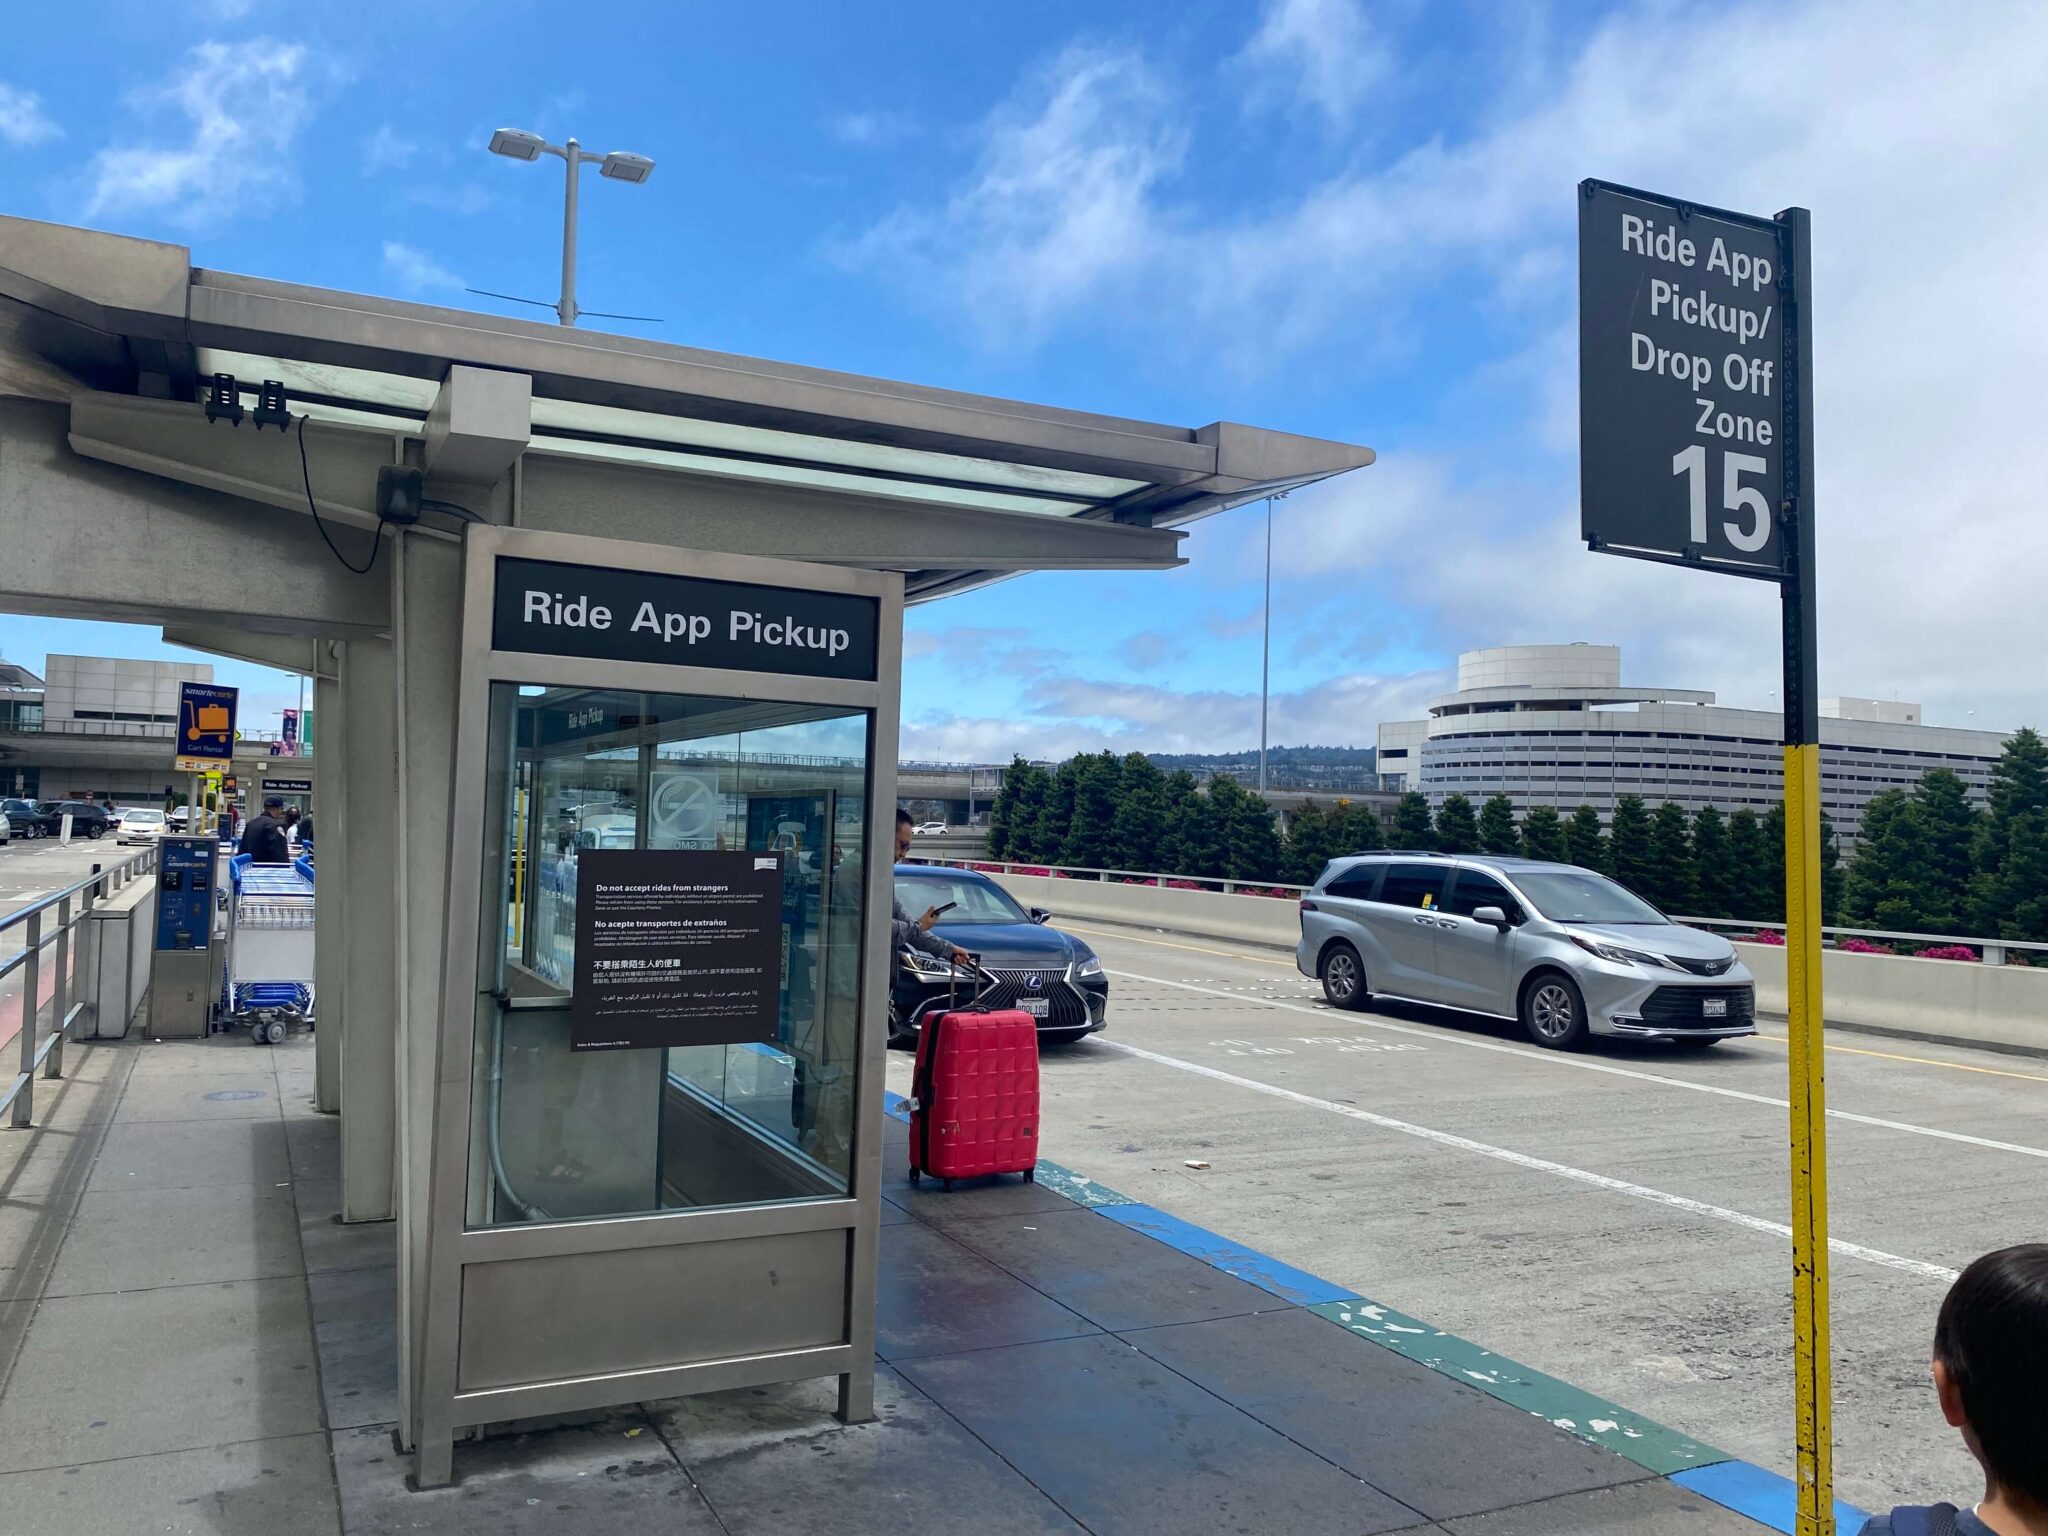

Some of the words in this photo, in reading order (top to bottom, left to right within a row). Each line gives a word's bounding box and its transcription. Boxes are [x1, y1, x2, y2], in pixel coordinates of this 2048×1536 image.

[1621, 213, 1696, 267] Ride
[1706, 237, 1772, 291] App
[1651, 278, 1772, 344] Pickup/
[1631, 332, 1712, 391] Drop
[1723, 353, 1774, 396] Off
[1695, 398, 1773, 446] Zone
[1672, 444, 1771, 553] 15
[523, 590, 612, 630] Ride
[630, 601, 711, 645] App
[729, 610, 850, 657] Pickup
[578, 710, 588, 730] App
[588, 706, 603, 725] Pickup
[596, 884, 608, 892] Do
[624, 885, 651, 893] accept
[692, 884, 729, 893] strangers
[594, 920, 607, 928] No
[608, 921, 635, 929] acepte
[636, 920, 681, 928] transportes
[682, 919, 693, 927] de
[694, 919, 727, 927] extraños
